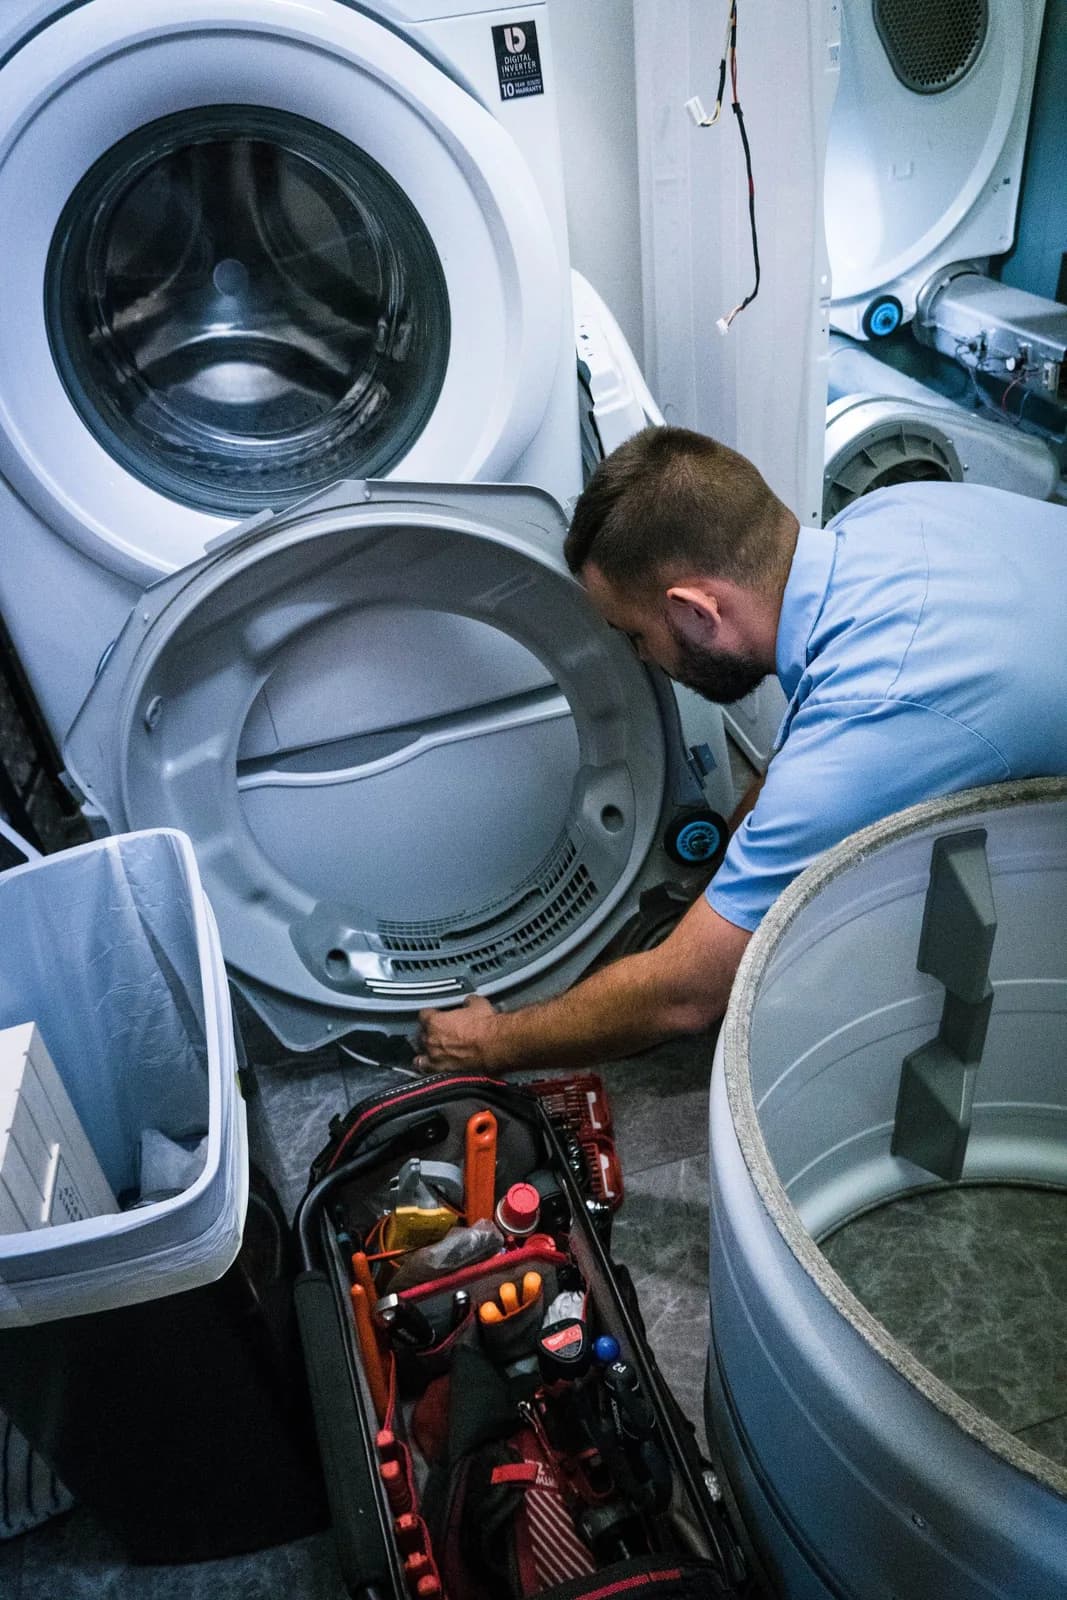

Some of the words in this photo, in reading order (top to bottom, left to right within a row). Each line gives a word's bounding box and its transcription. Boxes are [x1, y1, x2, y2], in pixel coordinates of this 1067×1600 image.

[504, 53, 532, 65] DIGITAL
[501, 60, 537, 73] INVERTER
[501, 82, 515, 97] 10
[515, 85, 542, 94] WARRANTY
